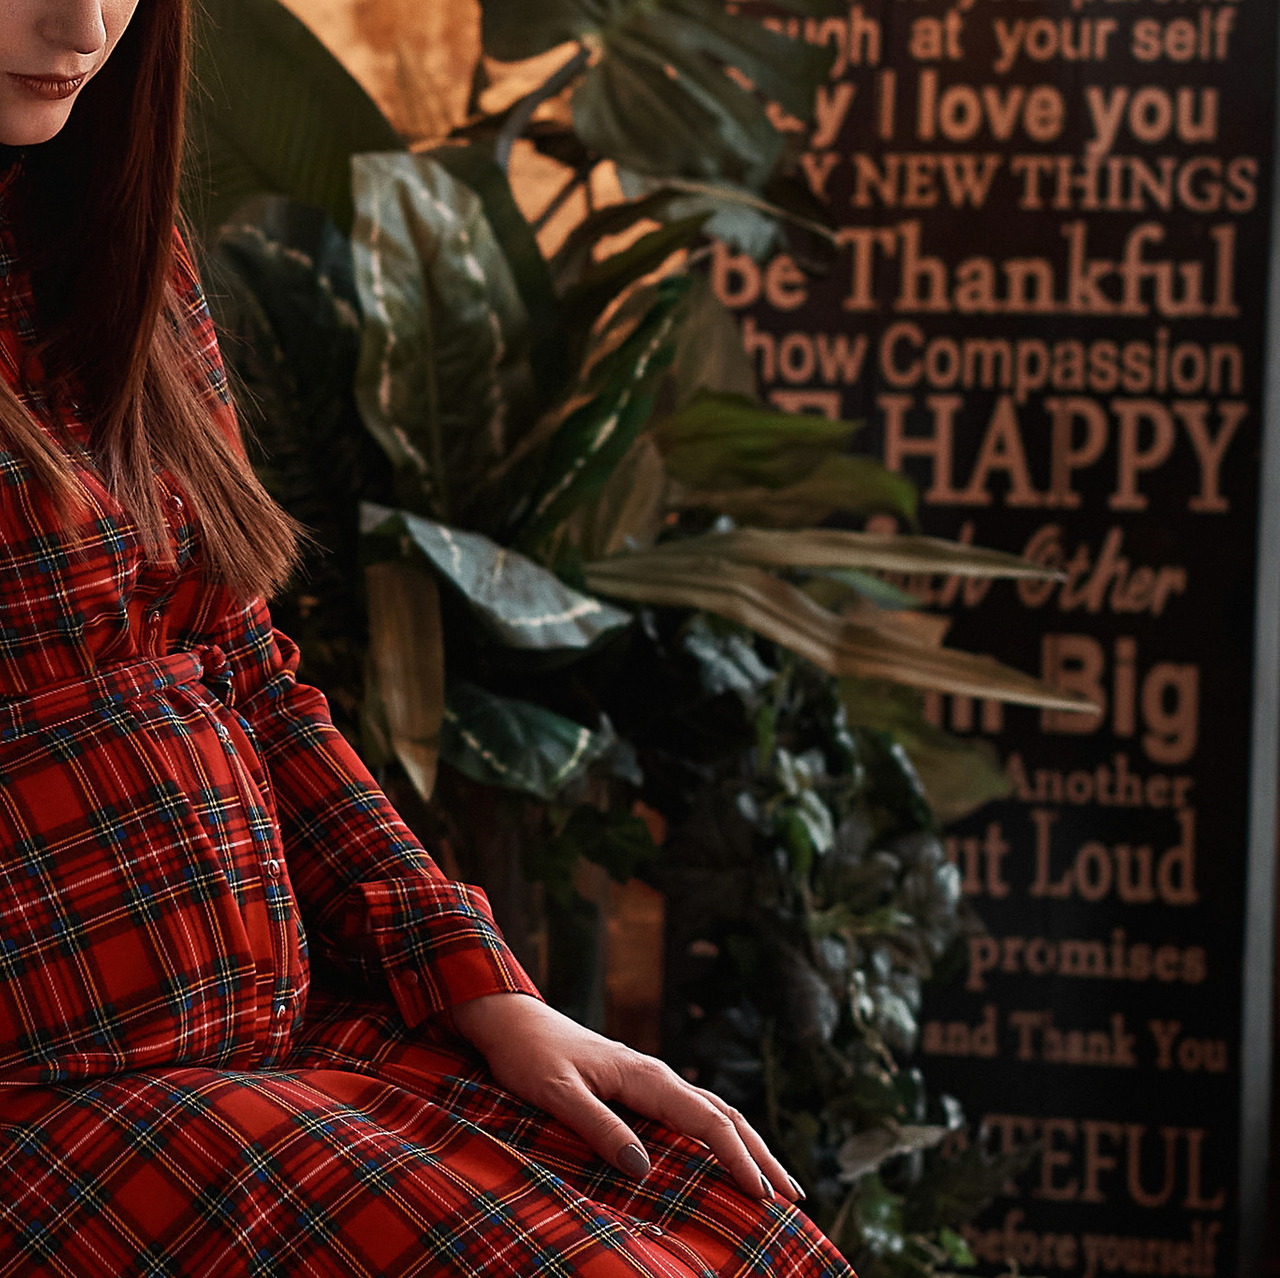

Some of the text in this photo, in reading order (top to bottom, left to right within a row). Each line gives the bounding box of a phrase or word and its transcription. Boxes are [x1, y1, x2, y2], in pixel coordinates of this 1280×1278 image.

[910, 9, 964, 61] at
[993, 19, 1117, 74] your
[1131, 6, 1237, 61] self
[878, 70, 897, 142] I
[917, 69, 1066, 142] love
[1085, 85, 1218, 159] you
[850, 153, 1003, 210] NEW
[1012, 154, 1259, 211] THINGS
[834, 219, 1240, 317] Thankful
[742, 316, 1242, 406] how Compassion
[877, 393, 1249, 513] HAPPY
[1041, 632, 1201, 765] Big
[1004, 751, 1194, 809] Another
[1030, 809, 1199, 906] Loud
[966, 928, 1209, 992] promises
[923, 1006, 1229, 1074] and Thank You
